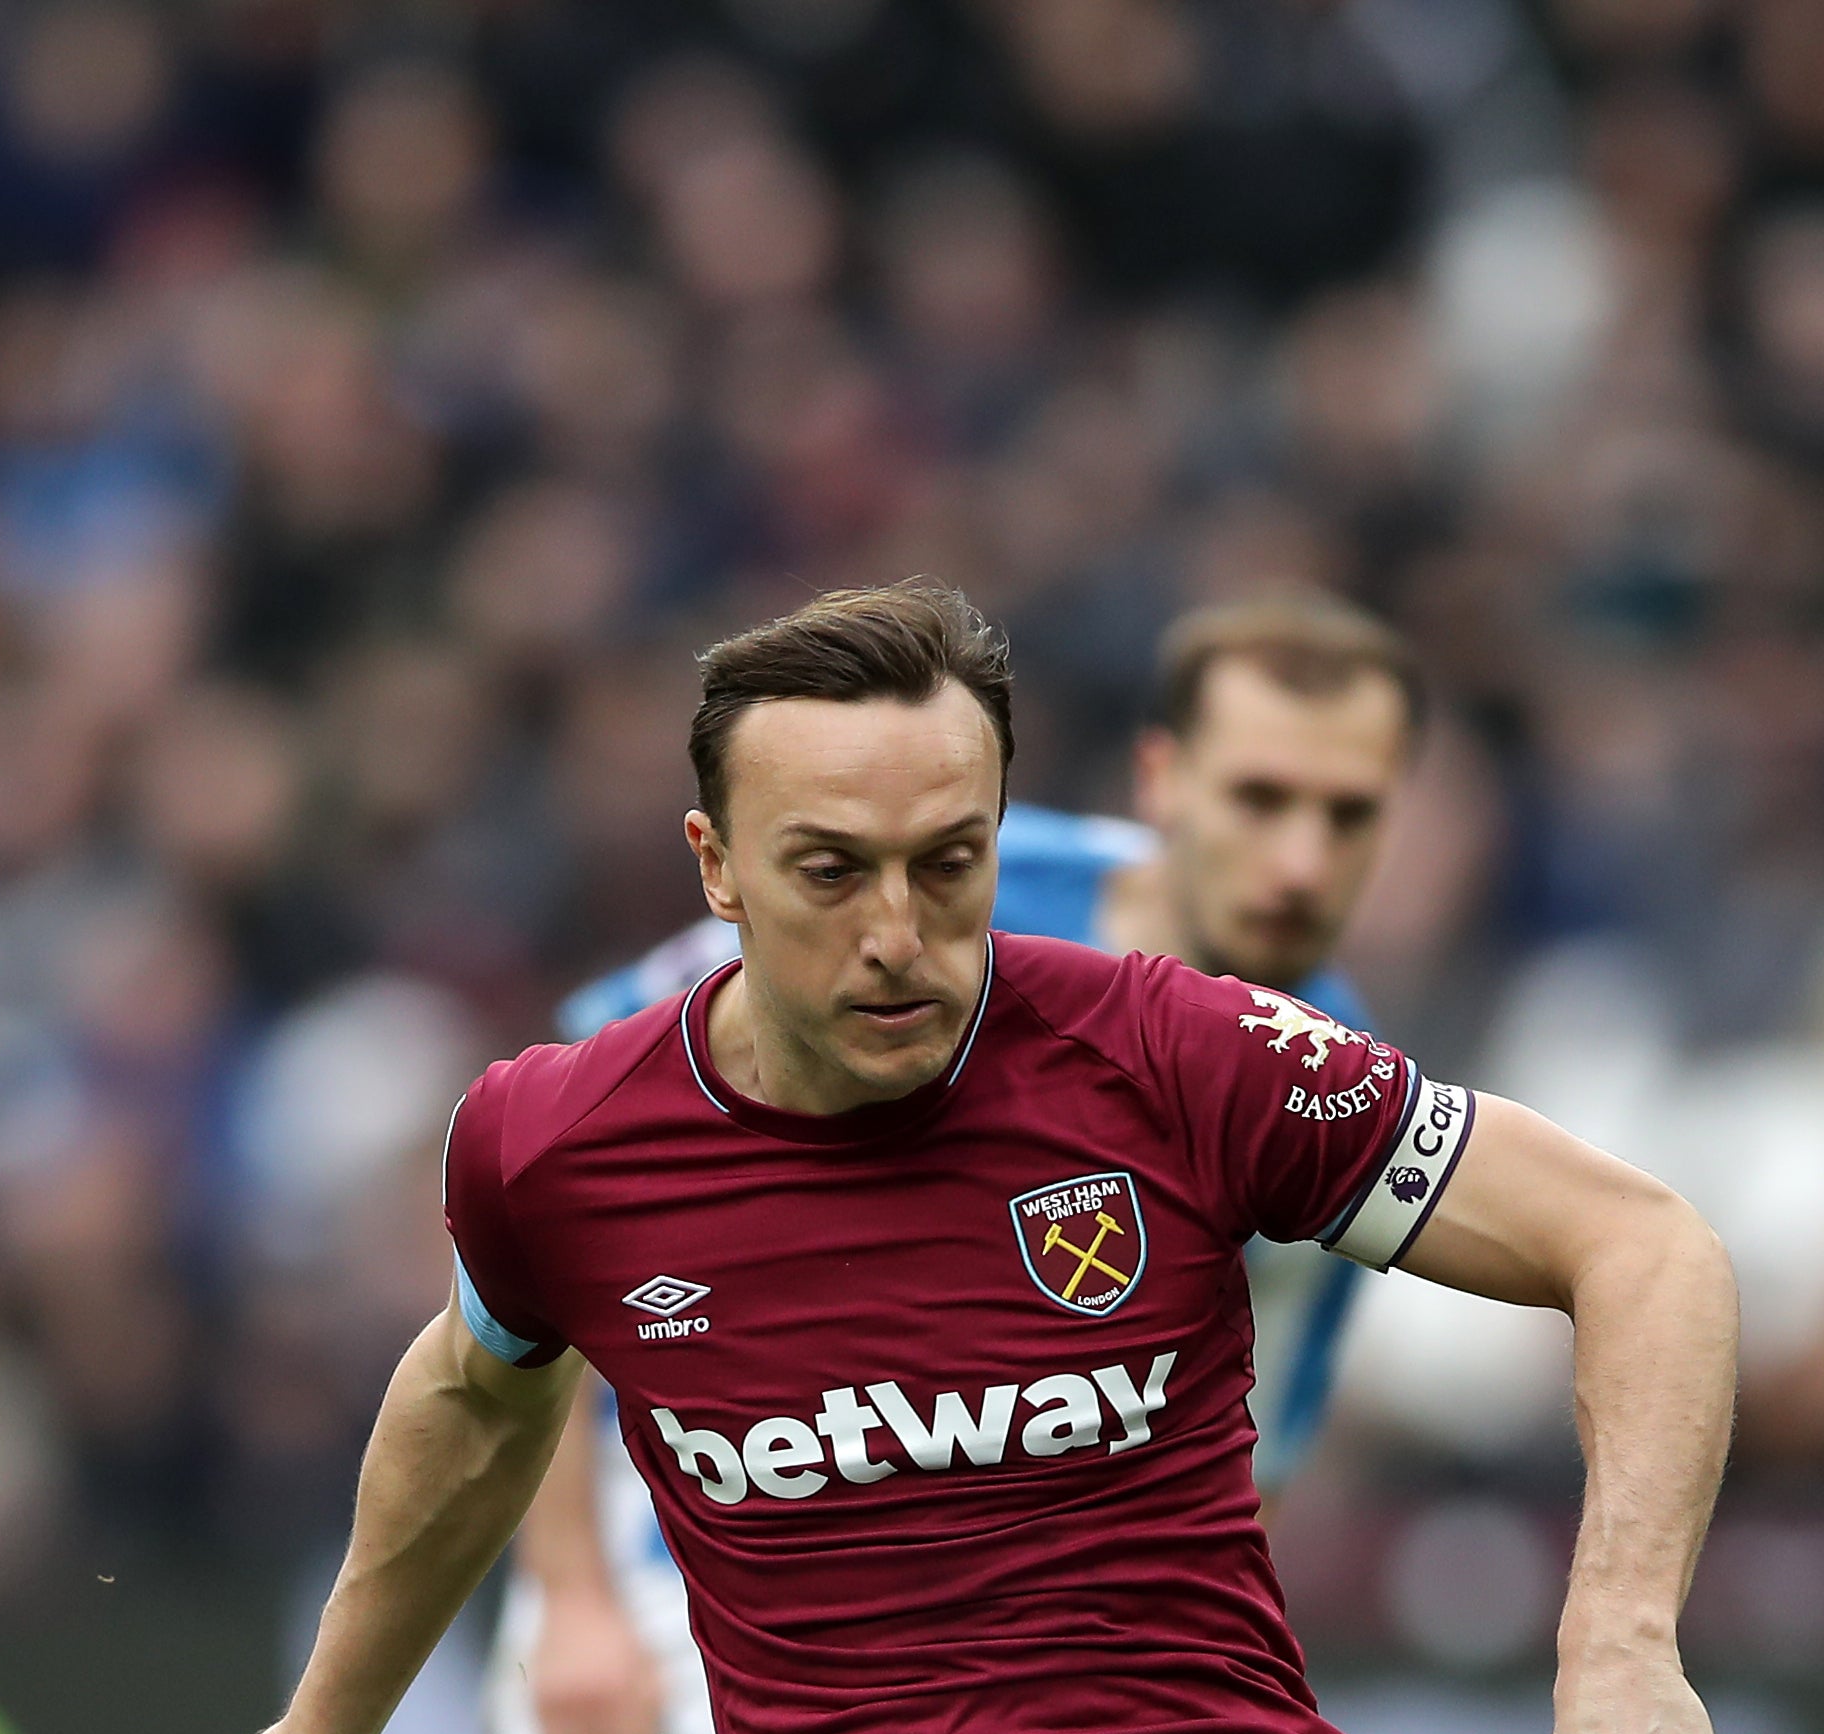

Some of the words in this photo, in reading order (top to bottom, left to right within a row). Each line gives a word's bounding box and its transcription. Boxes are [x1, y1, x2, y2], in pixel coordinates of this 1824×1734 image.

[1284, 1074, 1382, 1121] BASSET
[1371, 1058, 1396, 1081] &
[1022, 1190, 1071, 1217] WEST
[1074, 1180, 1121, 1202] HAM
[1045, 1197, 1103, 1221] UNITED
[1077, 1286, 1120, 1306] LONDON
[637, 1317, 710, 1340] umbro
[650, 1350, 1178, 1505] betway
